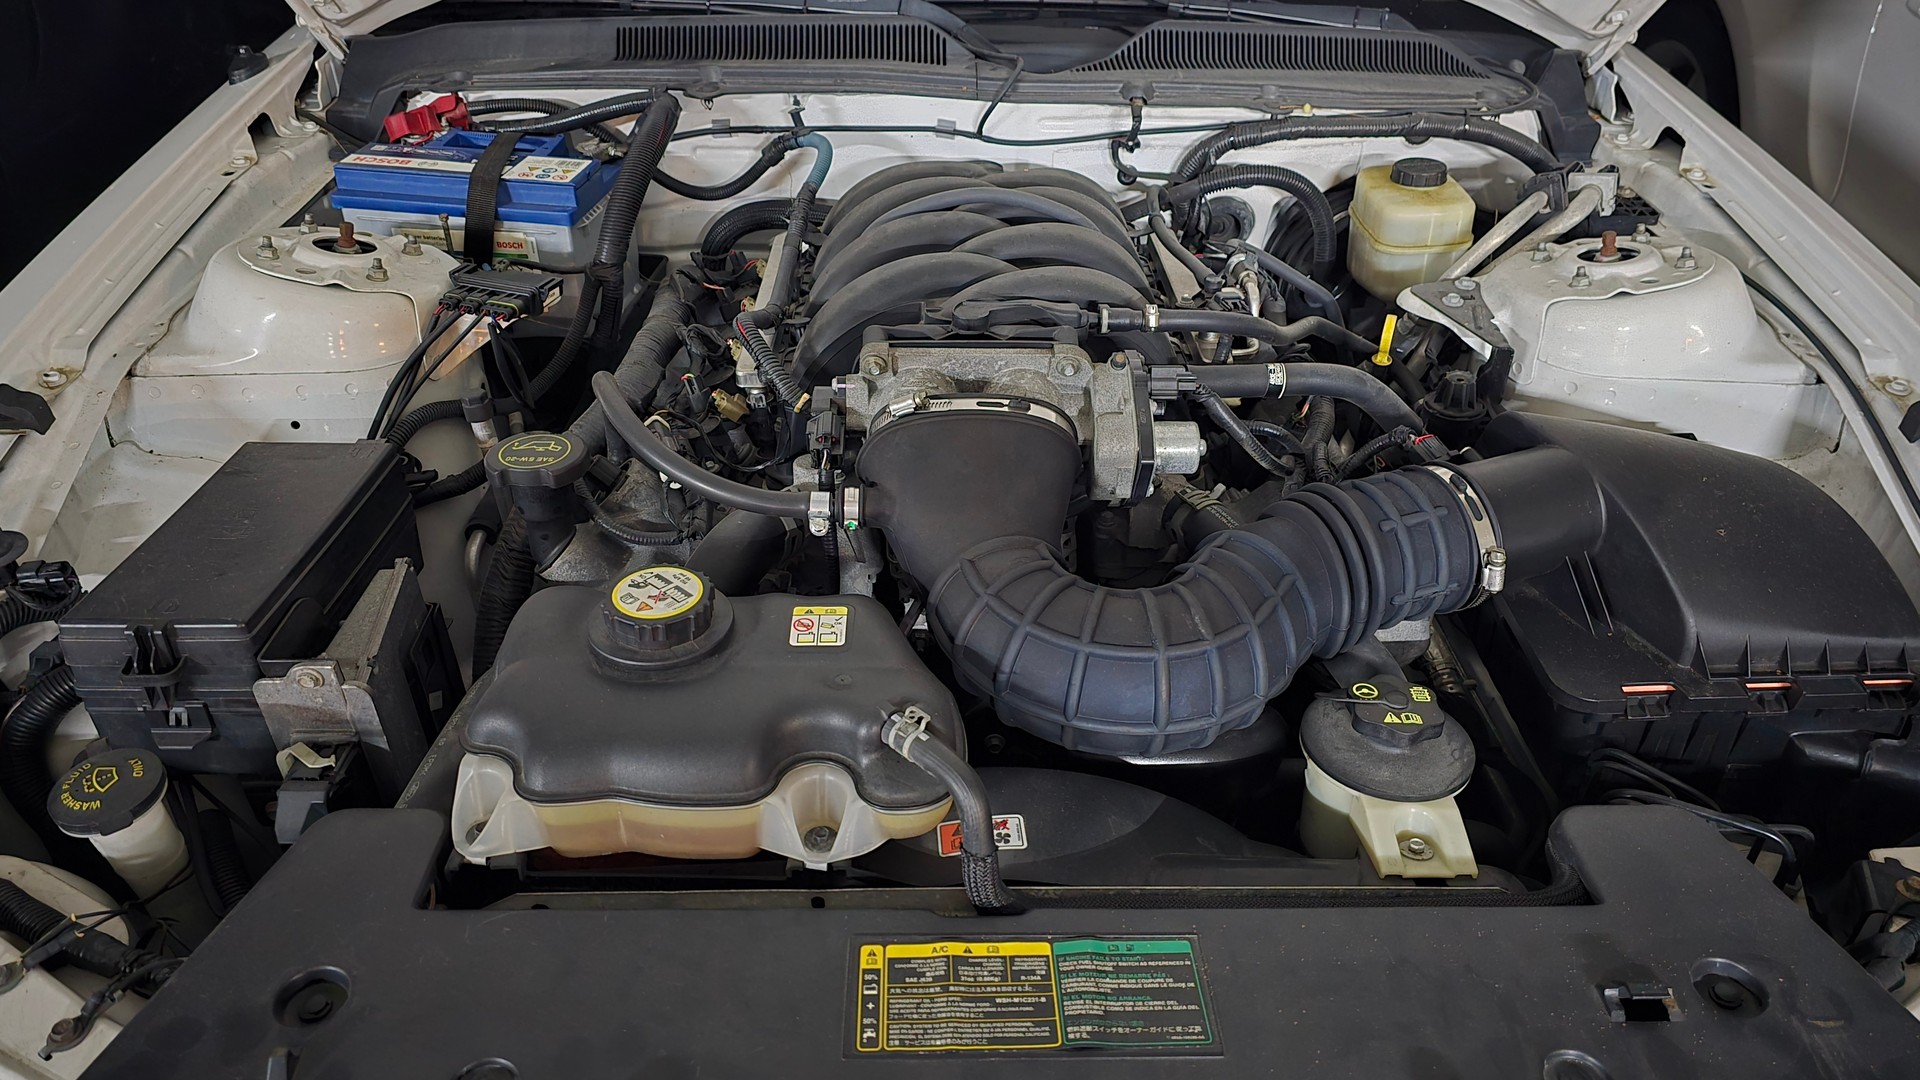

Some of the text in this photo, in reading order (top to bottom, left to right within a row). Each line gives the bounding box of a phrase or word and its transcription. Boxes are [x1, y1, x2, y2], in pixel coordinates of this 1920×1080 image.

[353, 156, 412, 165] BOSCH
[496, 241, 523, 249] BOSCH
[61, 758, 144, 811] WASHER FLUID ONLY
[931, 946, 948, 954] A/C
